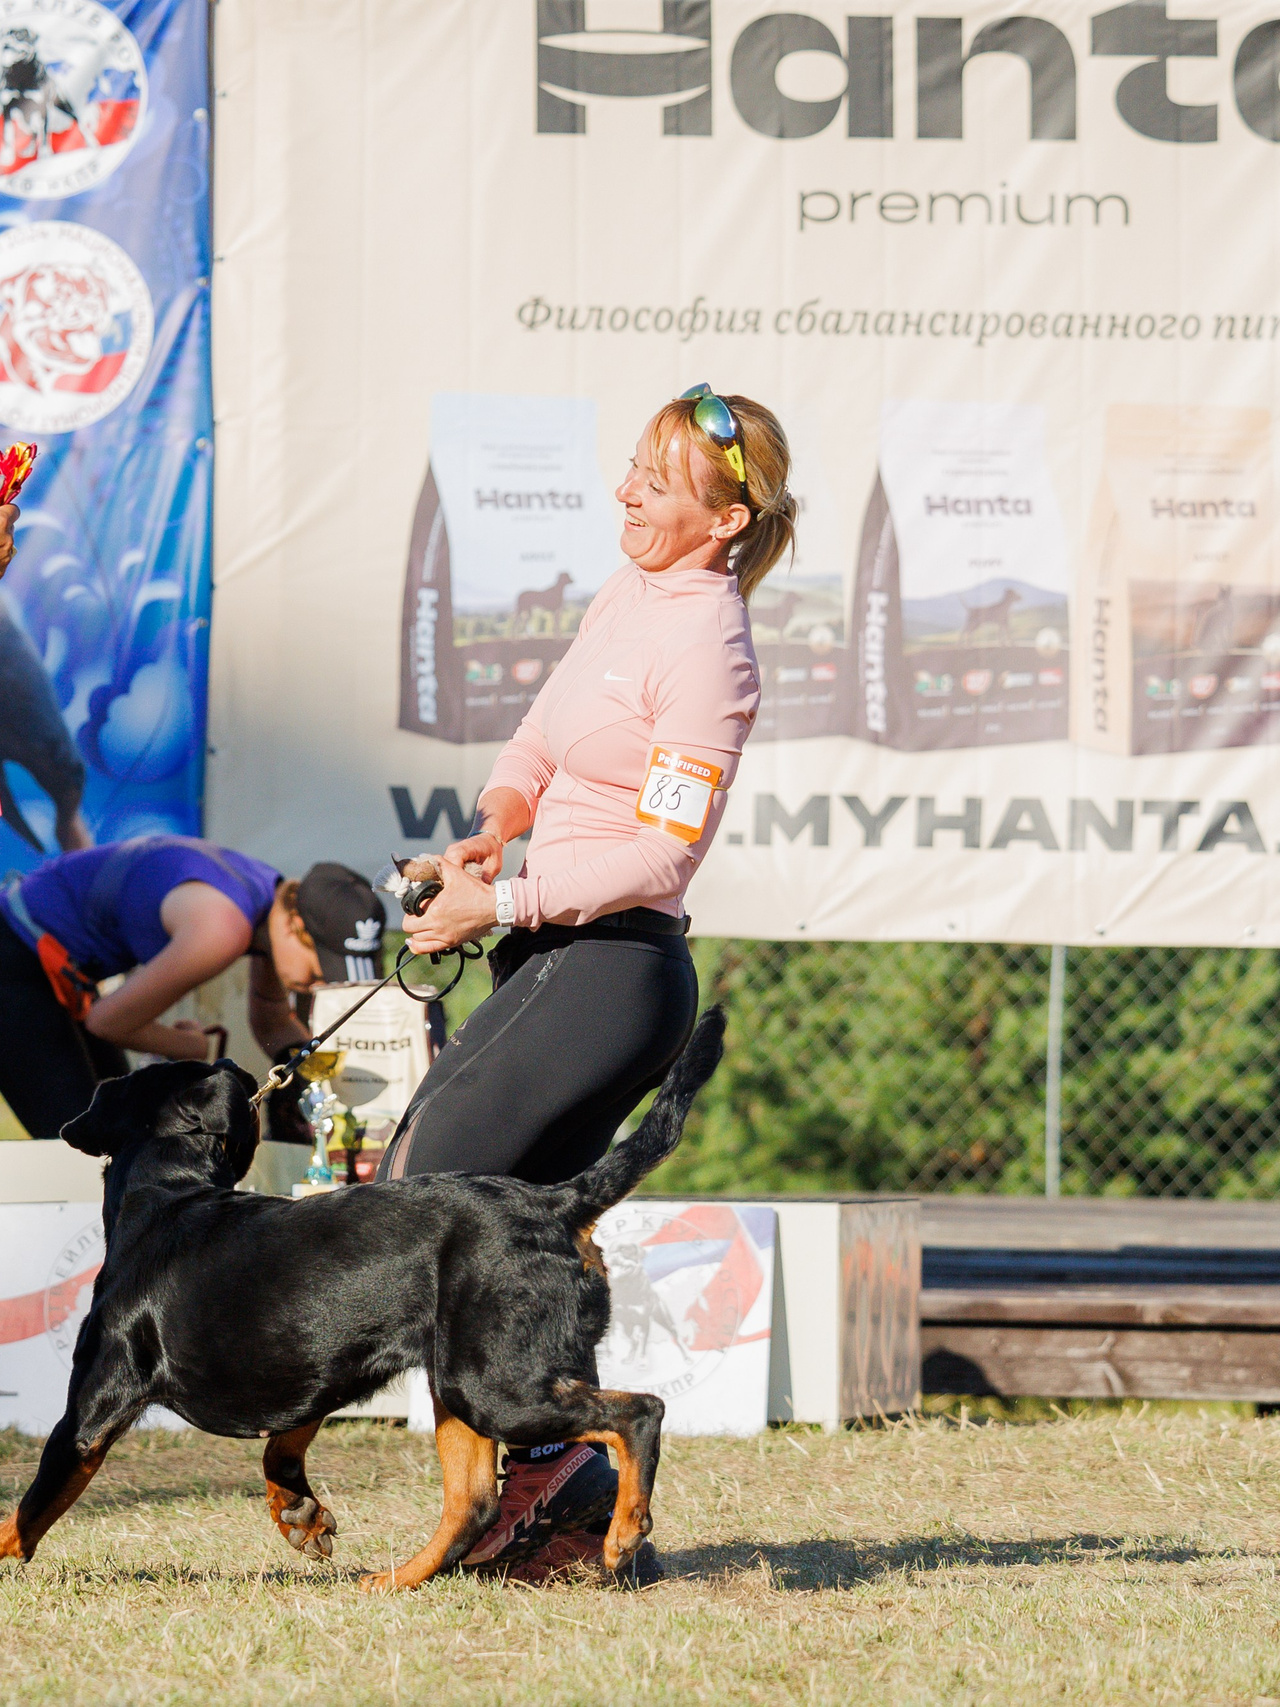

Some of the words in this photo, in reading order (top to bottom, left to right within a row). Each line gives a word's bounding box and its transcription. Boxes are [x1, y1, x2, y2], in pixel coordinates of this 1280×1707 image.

[797, 180, 1131, 232] premium
[515, 295, 762, 343] Философия
[772, 297, 1202, 347] сбалансированного
[474, 487, 585, 511] Hanta
[924, 493, 1034, 518] Hanta
[1149, 498, 1258, 520] Hanta
[657, 752, 712, 778] PROFIFEED
[648, 774, 692, 811] 85
[336, 1036, 411, 1052] Hanta
[548, 1447, 595, 1493] SALOMON
